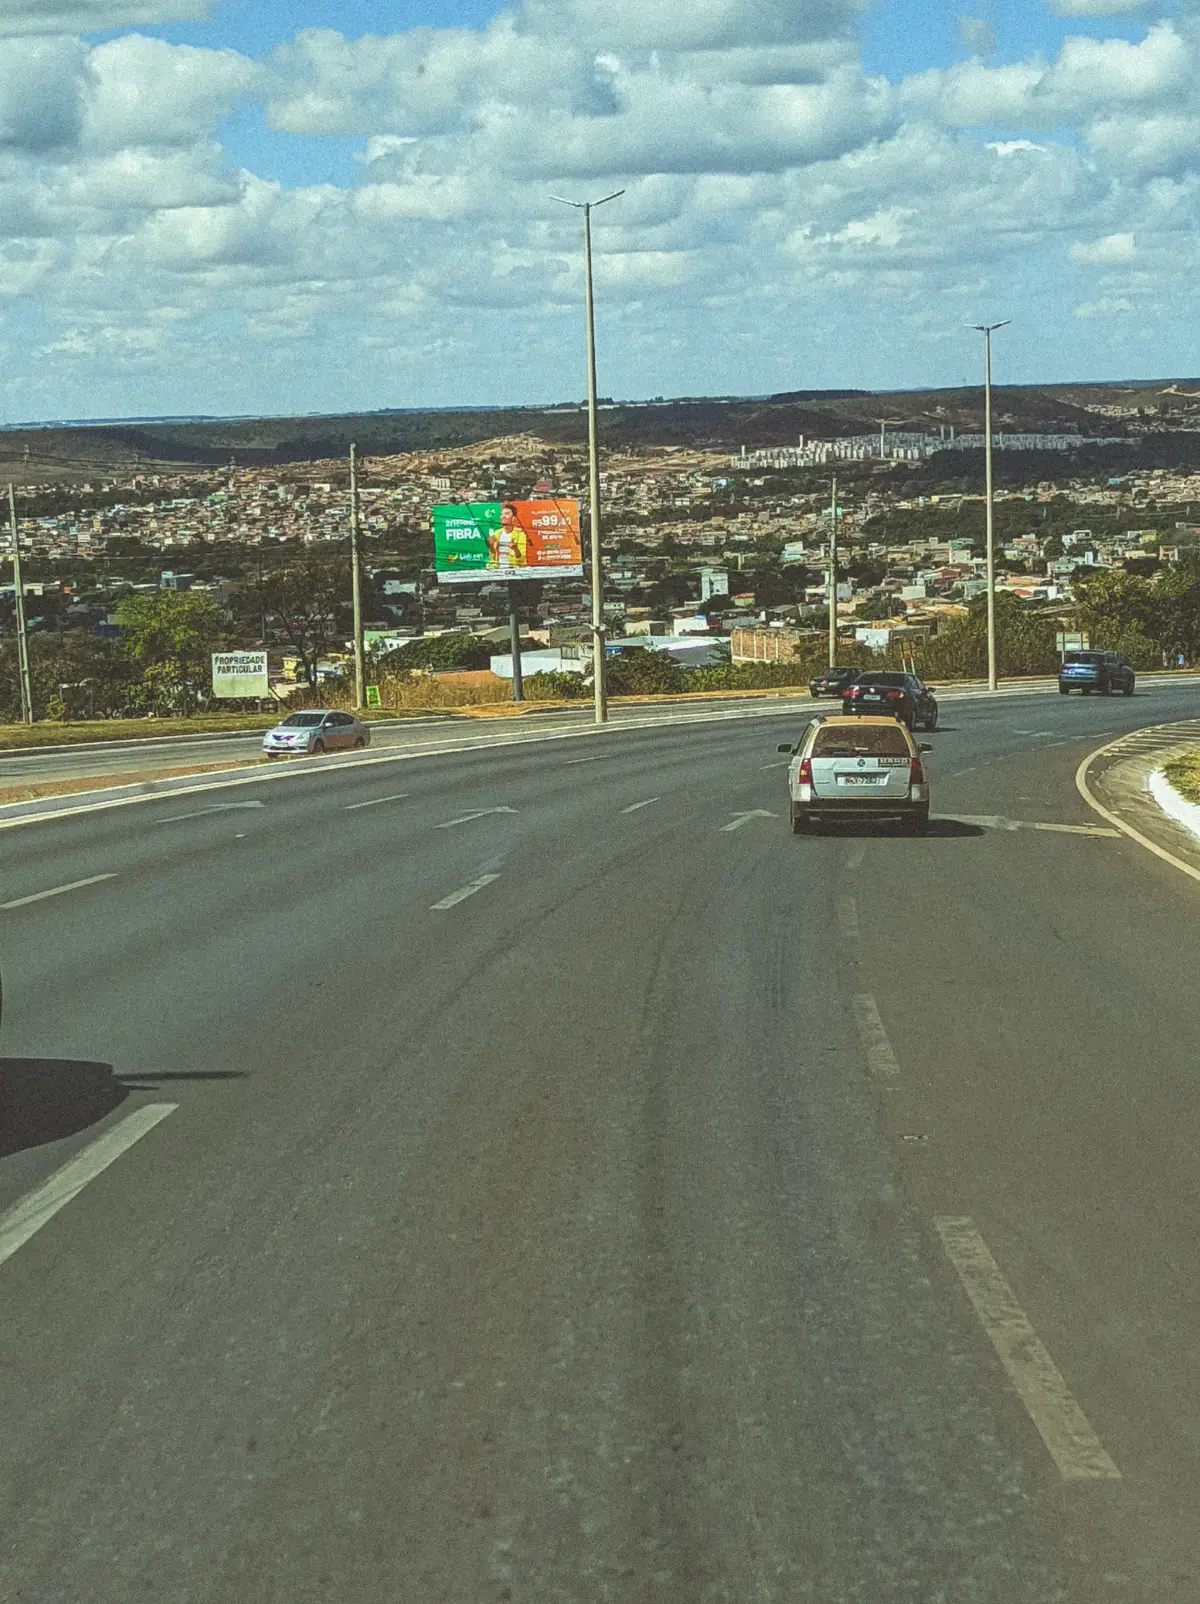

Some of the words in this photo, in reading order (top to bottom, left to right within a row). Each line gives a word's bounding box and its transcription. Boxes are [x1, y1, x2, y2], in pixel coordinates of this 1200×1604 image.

[446, 528, 481, 540] FIBRA
[215, 655, 265, 665] PROPRIEDADE
[217, 665, 262, 674] PARTICULAR
